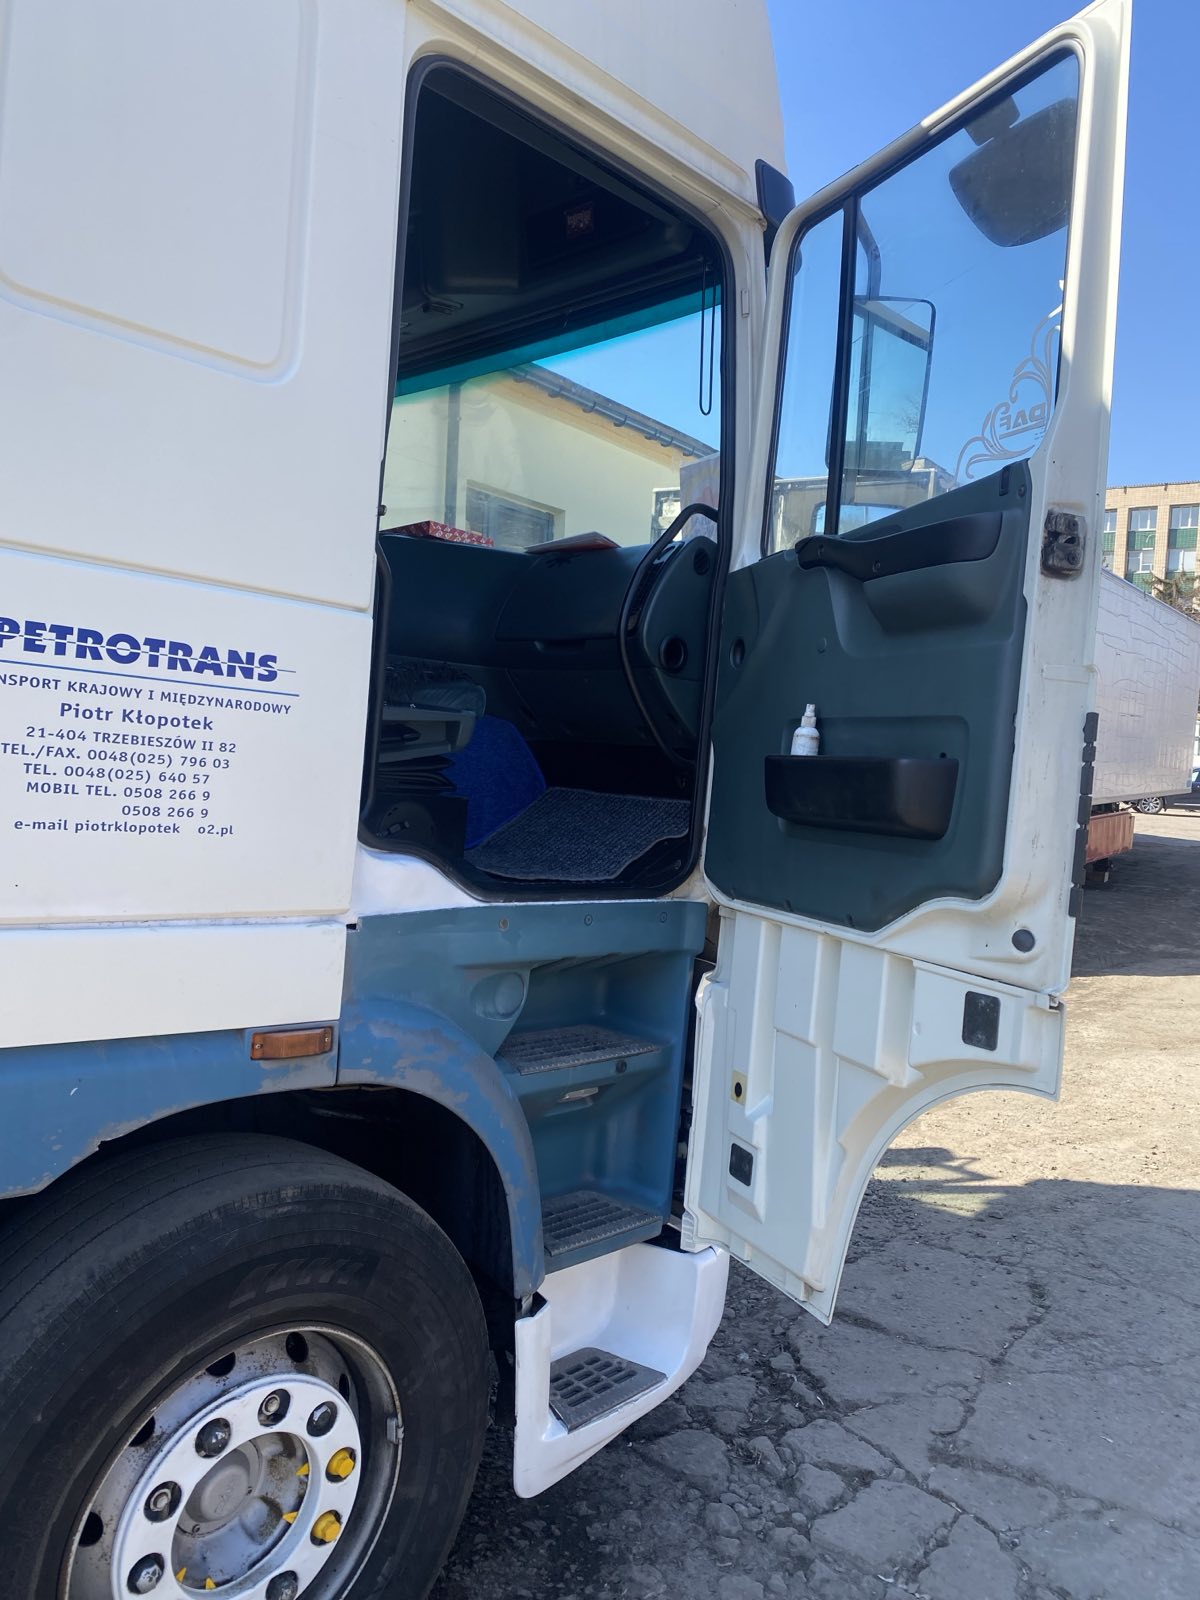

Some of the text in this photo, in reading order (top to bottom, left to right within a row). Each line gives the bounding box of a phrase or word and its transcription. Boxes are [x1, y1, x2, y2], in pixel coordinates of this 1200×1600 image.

[0, 616, 278, 682] PETROTRANS
[67, 680, 142, 699] KRAJOWY
[148, 689, 154, 700] I
[160, 691, 291, 714] MIĘDZYNARODOWY
[60, 702, 214, 730] Piotr Kłopotek
[26, 726, 236, 752] 21-404 TRZEBIESZÓW II 82
[1, 742, 230, 769] TEL./FAX. 0048(025) 796 03
[24, 762, 210, 784] TEL. 0048(025) 640 57
[26, 781, 211, 801] MOBIL TEL. 0508 266 9
[121, 805, 209, 819] 0508 266 9
[14, 819, 234, 837] e-mail piotrklopotek o2.pl
